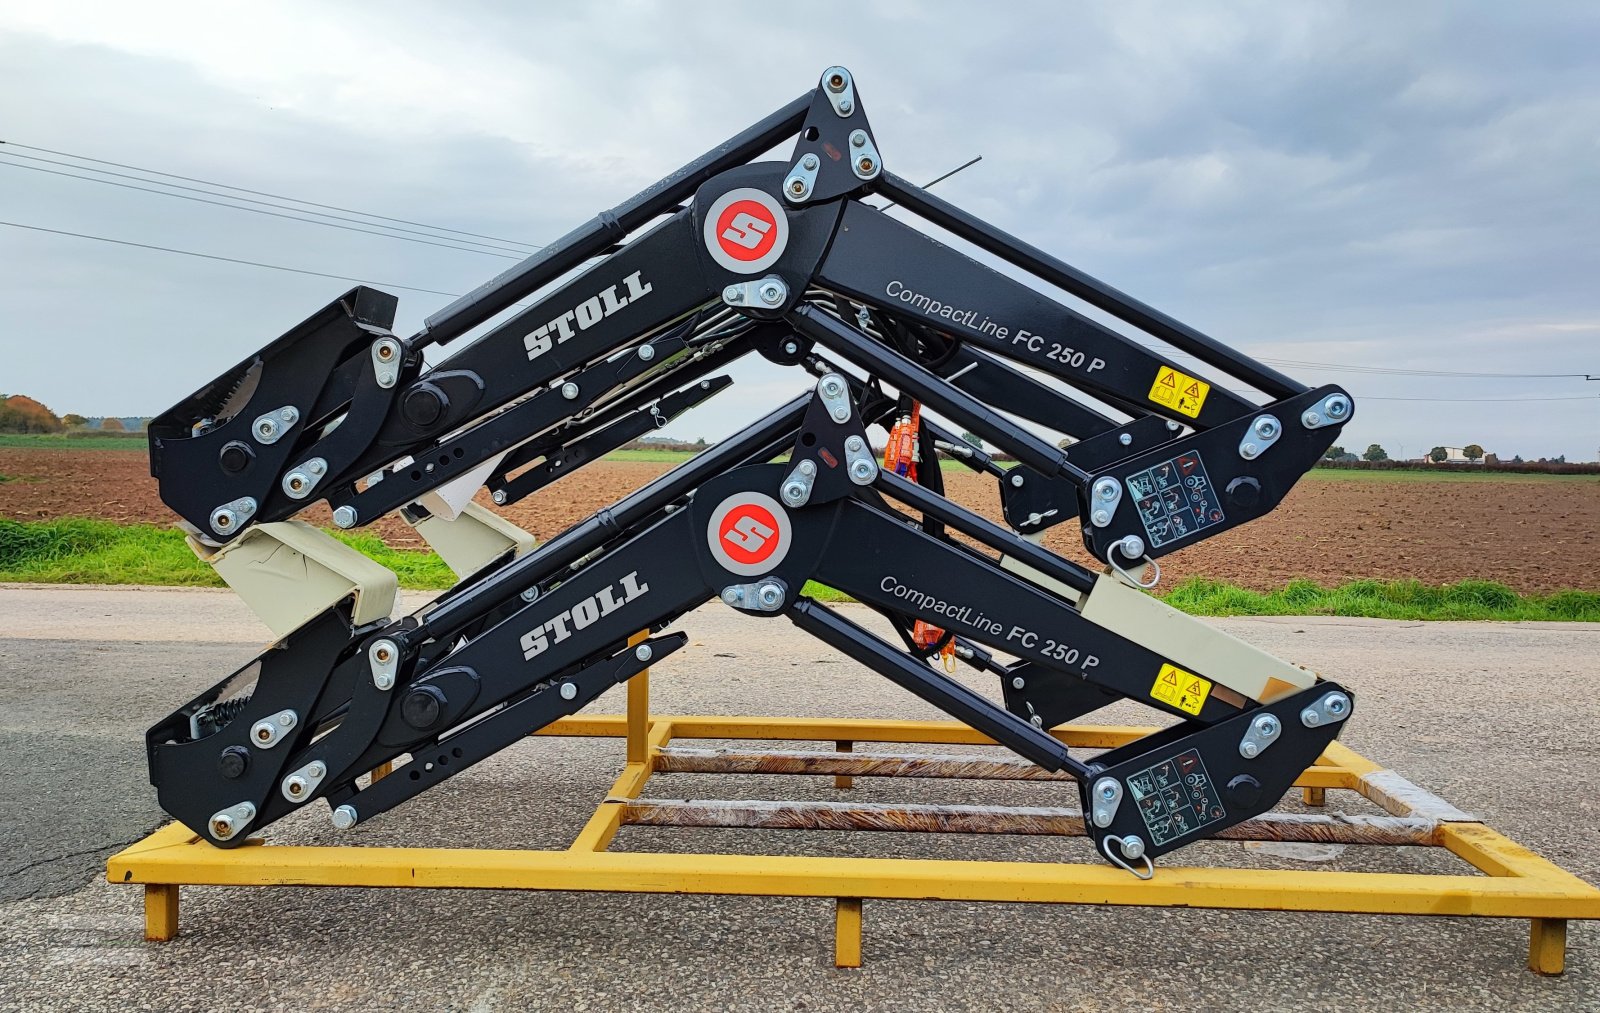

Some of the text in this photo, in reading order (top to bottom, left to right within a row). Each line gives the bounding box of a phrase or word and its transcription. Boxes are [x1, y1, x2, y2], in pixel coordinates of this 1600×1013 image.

[523, 270, 652, 361] STOLL
[886, 280, 1106, 373] CompactLine FC 250 P
[520, 571, 649, 661] STOLL
[880, 576, 1100, 671] CompactLine FC 250 P
